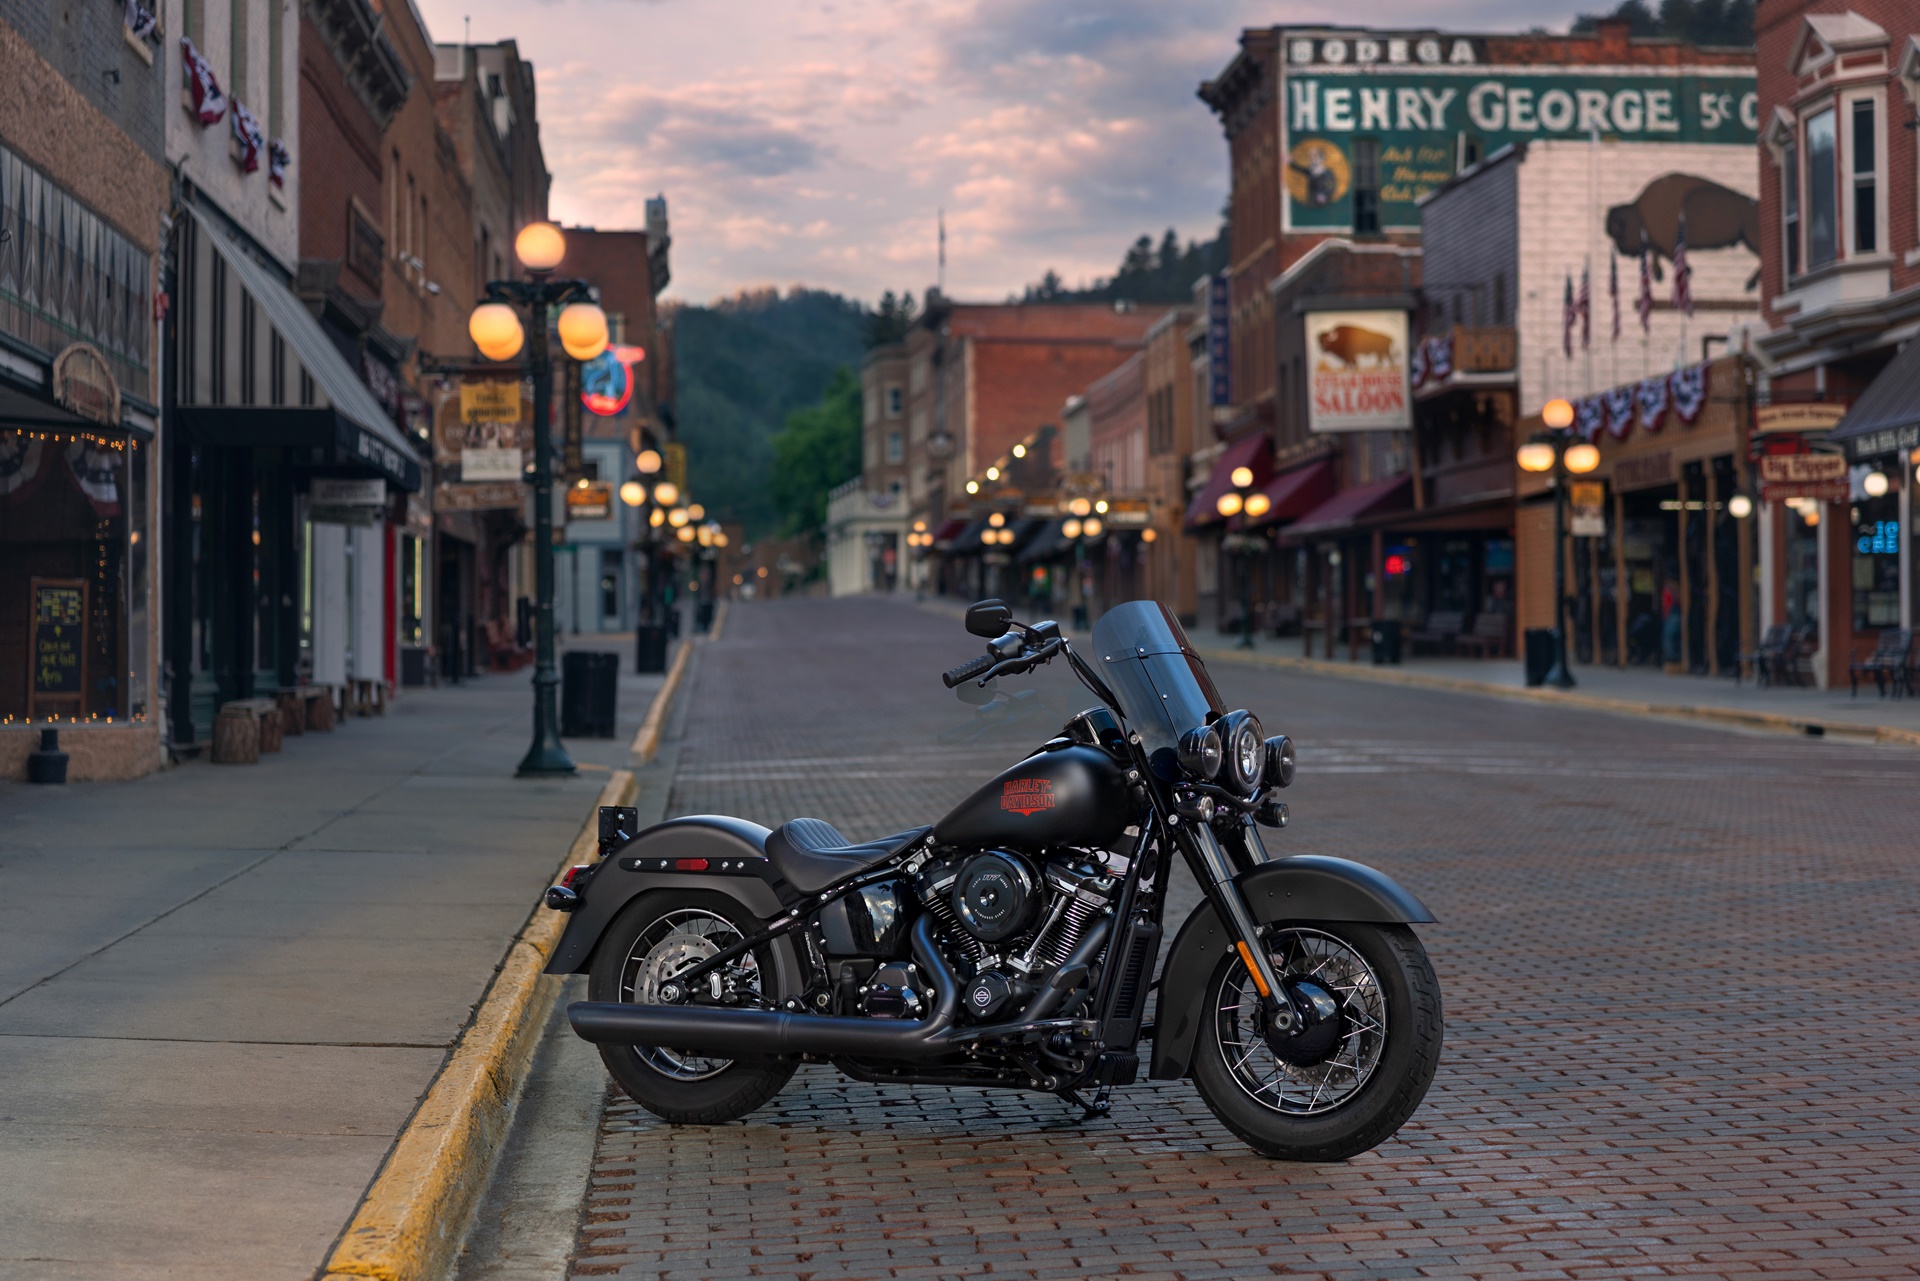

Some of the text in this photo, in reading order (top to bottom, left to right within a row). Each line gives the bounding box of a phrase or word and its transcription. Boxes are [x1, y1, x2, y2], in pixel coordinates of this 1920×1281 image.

[1289, 38, 1476, 63] BODEGA
[1290, 80, 1457, 131] HENRY
[1467, 81, 1680, 132] GEORGE
[1314, 390, 1404, 415] SALOON
[1000, 793, 1055, 810] DAVIDSON
